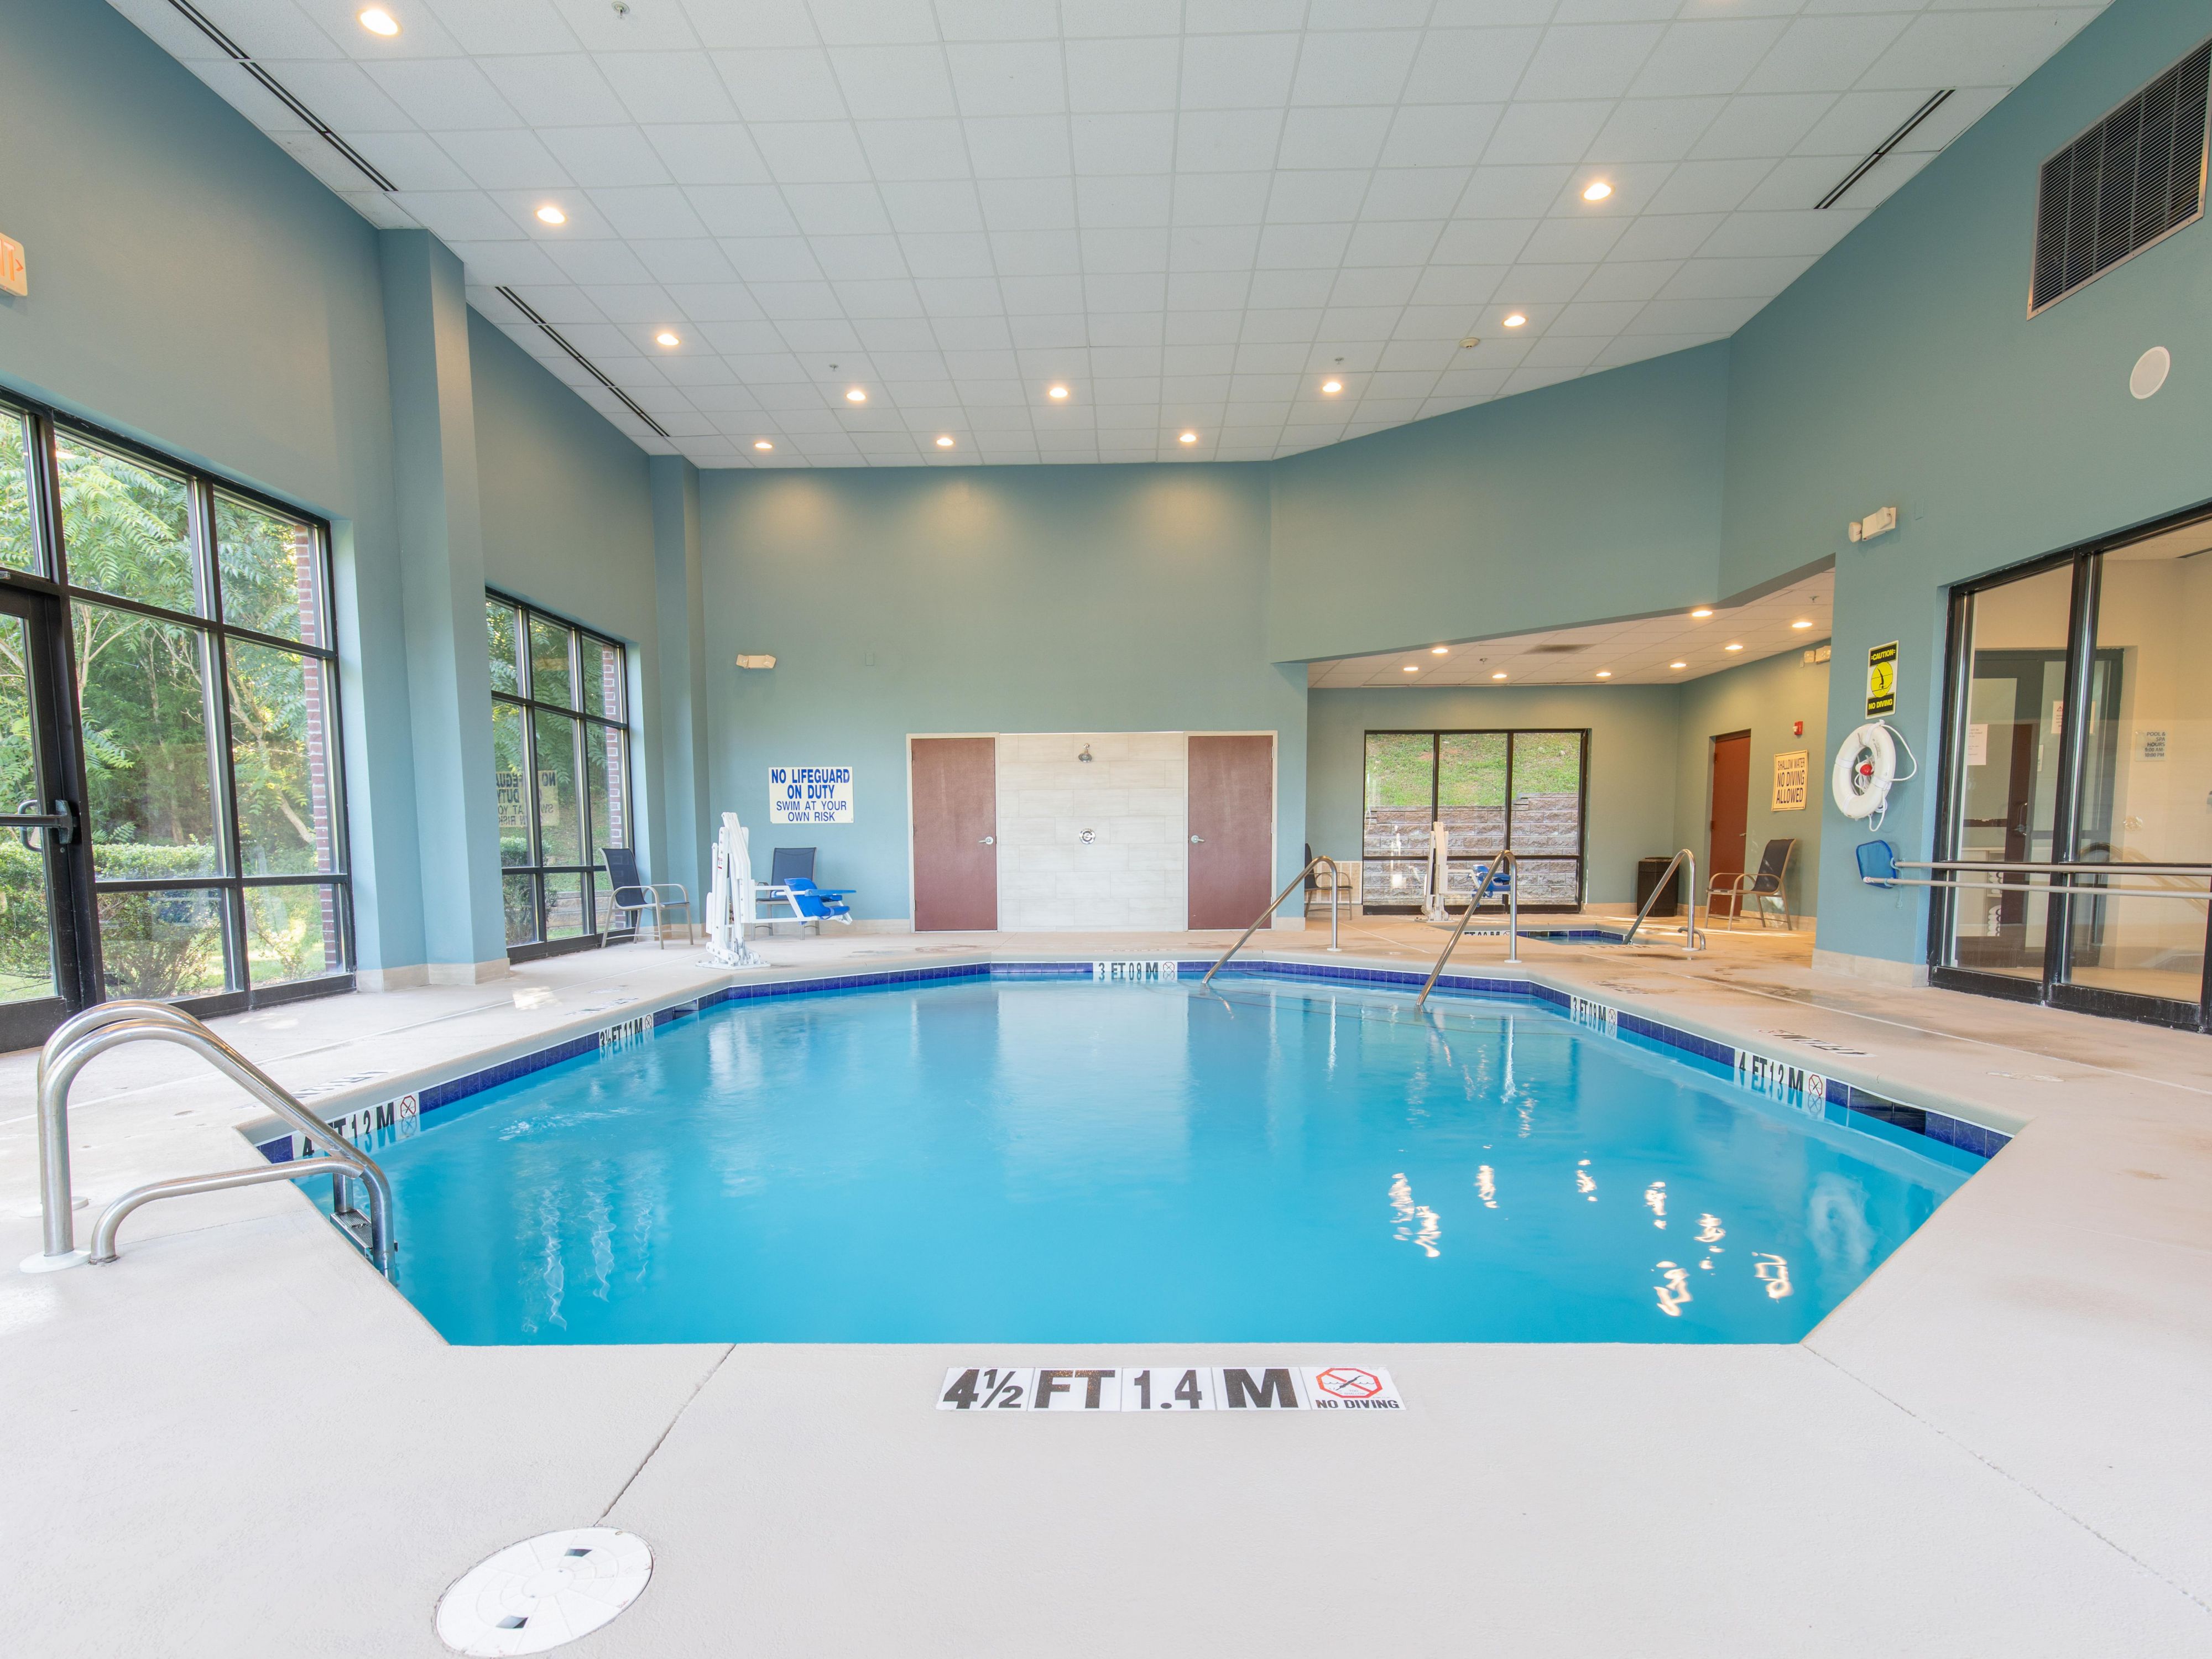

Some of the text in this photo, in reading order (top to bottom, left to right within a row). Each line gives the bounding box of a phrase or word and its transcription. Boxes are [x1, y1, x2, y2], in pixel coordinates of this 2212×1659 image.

[1872, 649, 1893, 661] CAUTION
[1876, 698, 1893, 708] DIVING
[1777, 757, 1805, 771] SHALLOW WATER
[771, 769, 850, 784] NO LIFEGUARD
[1777, 769, 1805, 787] NO DIVING
[787, 784, 835, 800] ON DUTY
[1776, 787, 1803, 805] ALLOWED
[776, 800, 847, 811] SWIM AT YOUR
[787, 811, 836, 822] OWN RISK
[612, 1024, 622, 1043] FT
[634, 1017, 643, 1034] M
[1739, 1051, 1746, 1071] 4
[1752, 1055, 1768, 1078] FT
[1788, 1067, 1804, 1092] M
[302, 1136, 315, 1157] 4
[376, 1102, 395, 1131] M
[1034, 1369, 1116, 1408] FT
[1134, 1369, 1203, 1410] 1.4
[1223, 1368, 1299, 1408] M
[1315, 1400, 1400, 1408] NO DIVING
